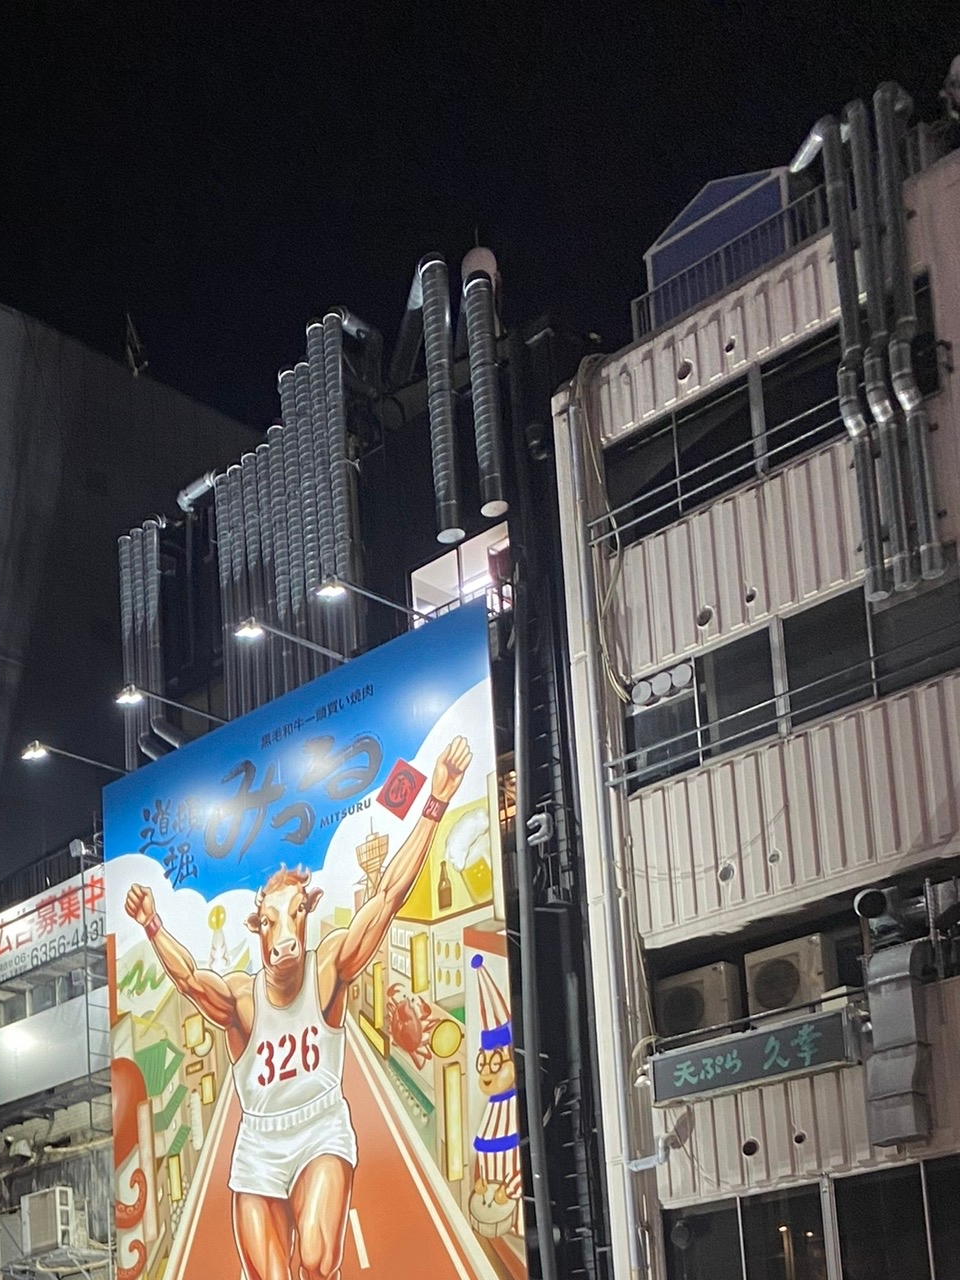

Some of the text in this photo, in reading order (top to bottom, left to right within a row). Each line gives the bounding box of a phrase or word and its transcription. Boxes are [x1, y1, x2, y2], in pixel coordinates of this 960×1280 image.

[204, 731, 383, 864] みつる
[320, 797, 372, 829] MITSURU
[256, 1025, 320, 1087] 326
[673, 1050, 742, 1088] 天ぷら
